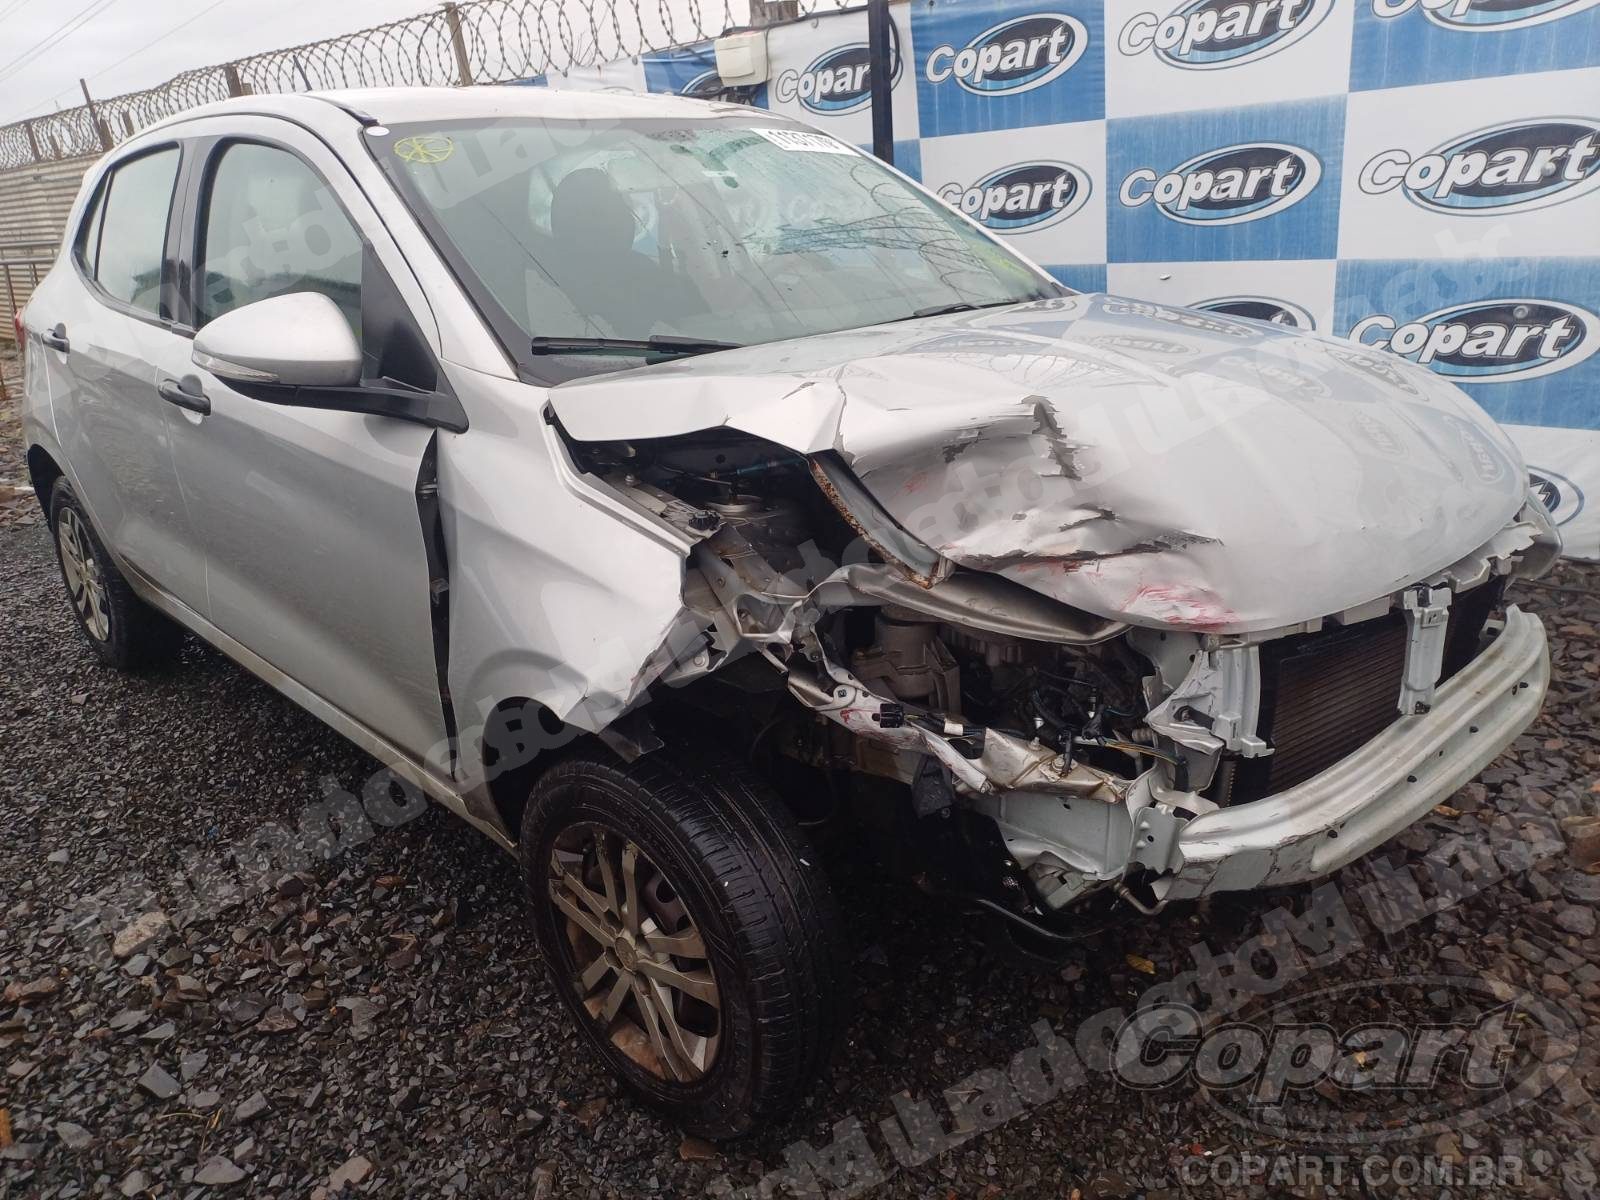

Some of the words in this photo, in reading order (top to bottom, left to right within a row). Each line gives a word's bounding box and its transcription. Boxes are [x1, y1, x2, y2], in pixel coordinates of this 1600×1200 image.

[926, 20, 1071, 83] Copart
[1118, 0, 1302, 56] Copart
[776, 63, 871, 104] Copar
[1119, 153, 1297, 211] Copart
[1357, 131, 1600, 199] Copart
[936, 174, 1072, 221] Copart
[1348, 313, 1575, 364] Copart
